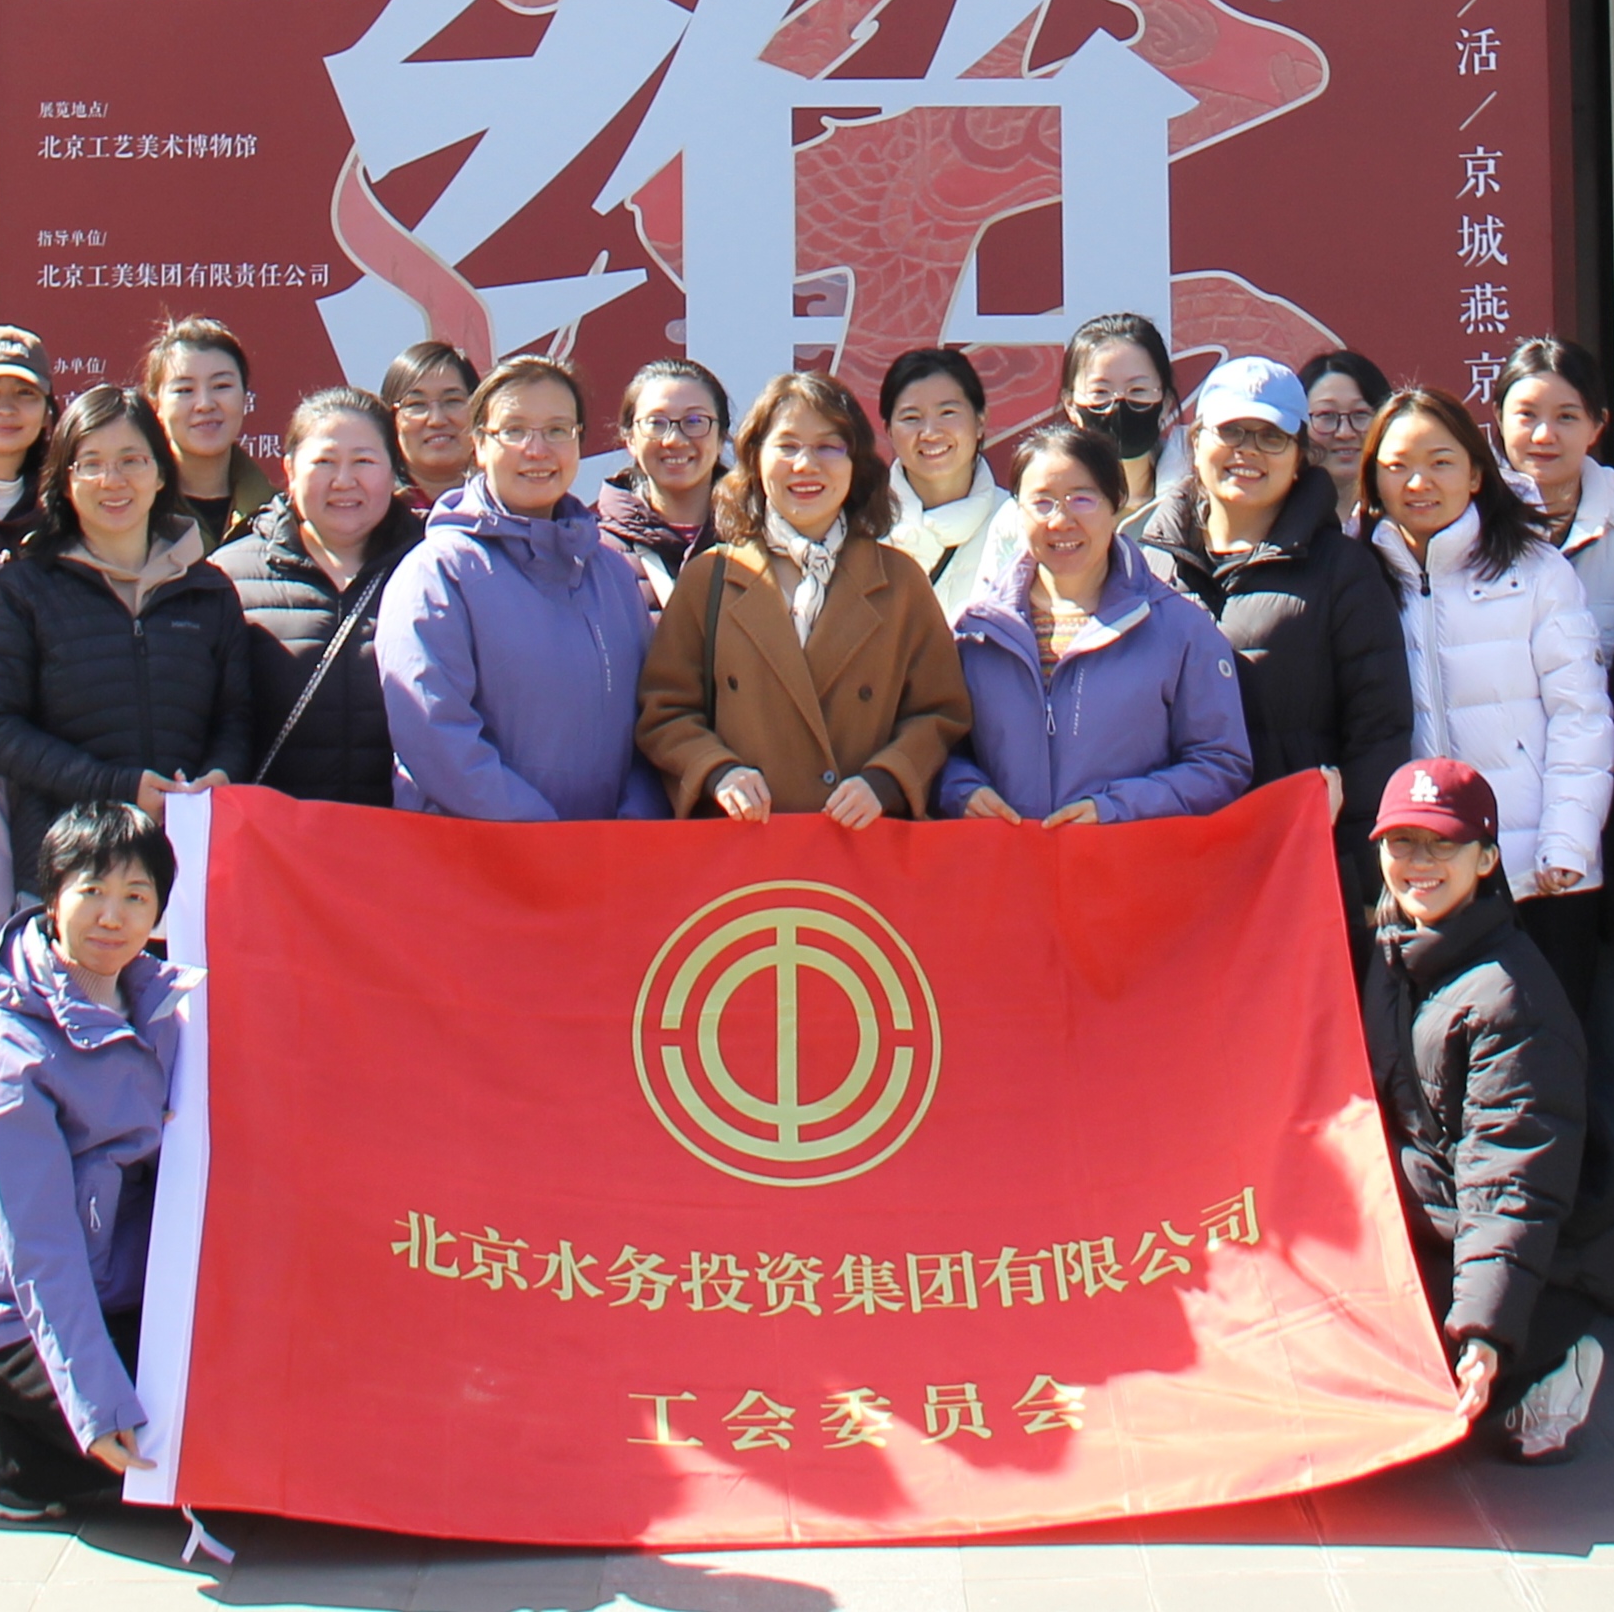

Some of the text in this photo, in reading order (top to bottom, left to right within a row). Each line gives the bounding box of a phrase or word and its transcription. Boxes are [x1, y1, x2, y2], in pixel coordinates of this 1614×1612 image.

[38, 101, 109, 119] 展览地点/
[37, 132, 258, 160] 北京工艺美术博物馆
[37, 229, 108, 248] 指导单位/
[36, 262, 331, 289] 北京工美集团有限责任公司
[391, 1187, 1260, 1318] 北京水务投资集团有限公司
[626, 1374, 1086, 1451] 工会委员会
